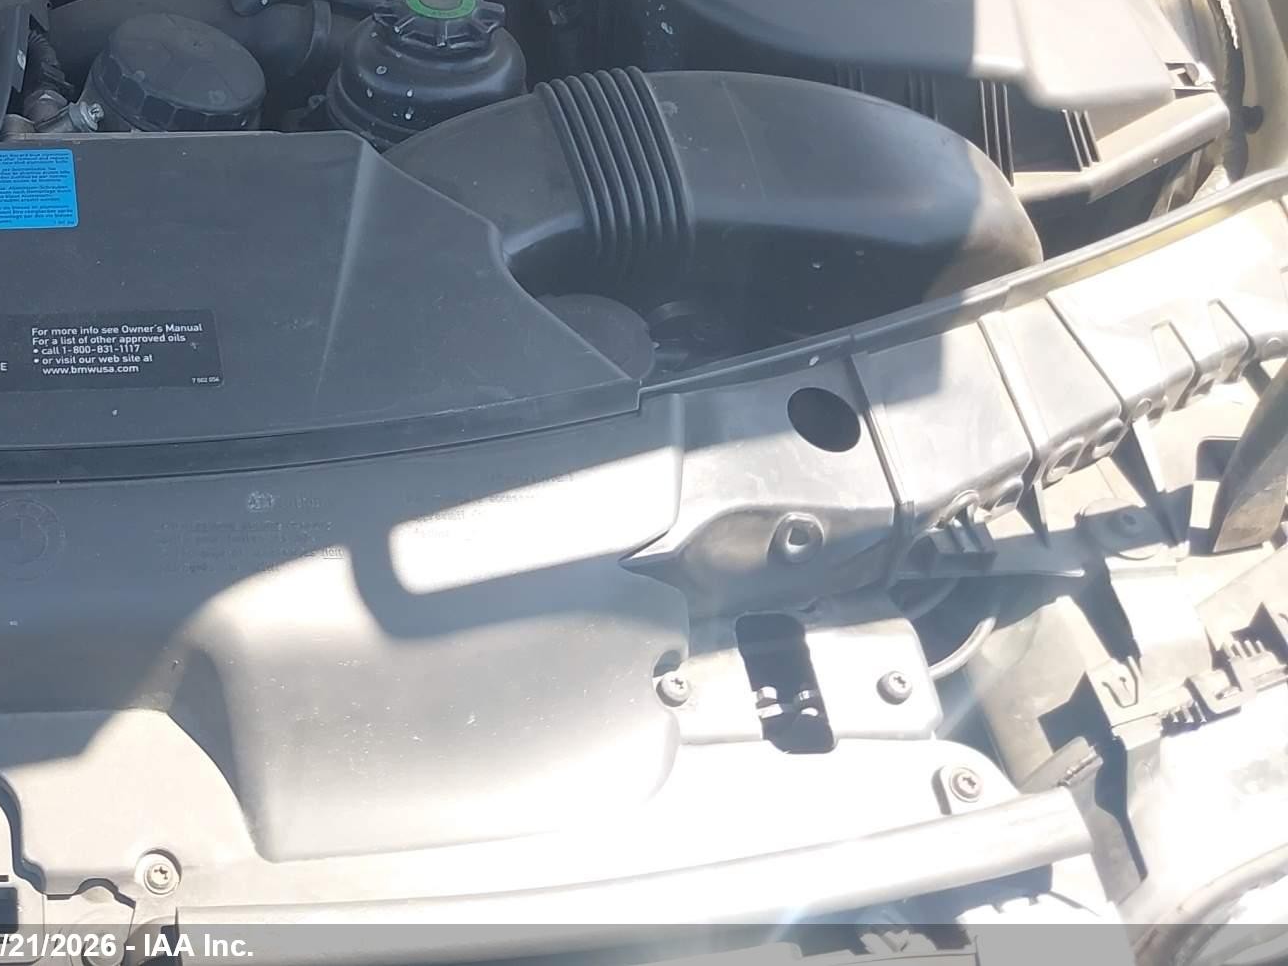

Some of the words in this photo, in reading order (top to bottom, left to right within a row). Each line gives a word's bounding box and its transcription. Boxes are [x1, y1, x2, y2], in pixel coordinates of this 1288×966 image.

[31, 328, 48, 336] For
[51, 327, 78, 335] more
[80, 326, 99, 335] info
[101, 326, 119, 334] see
[165, 323, 203, 333] Manual
[32, 337, 48, 346] For
[60, 336, 76, 345] list
[78, 335, 88, 344] of
[90, 335, 117, 344] other
[119, 334, 166, 344] approved
[168, 334, 186, 342] oils
[41, 346, 59, 355] call
[62, 344, 141, 354] 1-800-831-1117
[42, 356, 53, 365] or
[55, 355, 76, 364] visit
[78, 355, 96, 364] our
[98, 354, 120, 363] web
[122, 354, 140, 363] site
[142, 353, 153, 362] at
[41, 365, 140, 375] www.bmwusa.com
